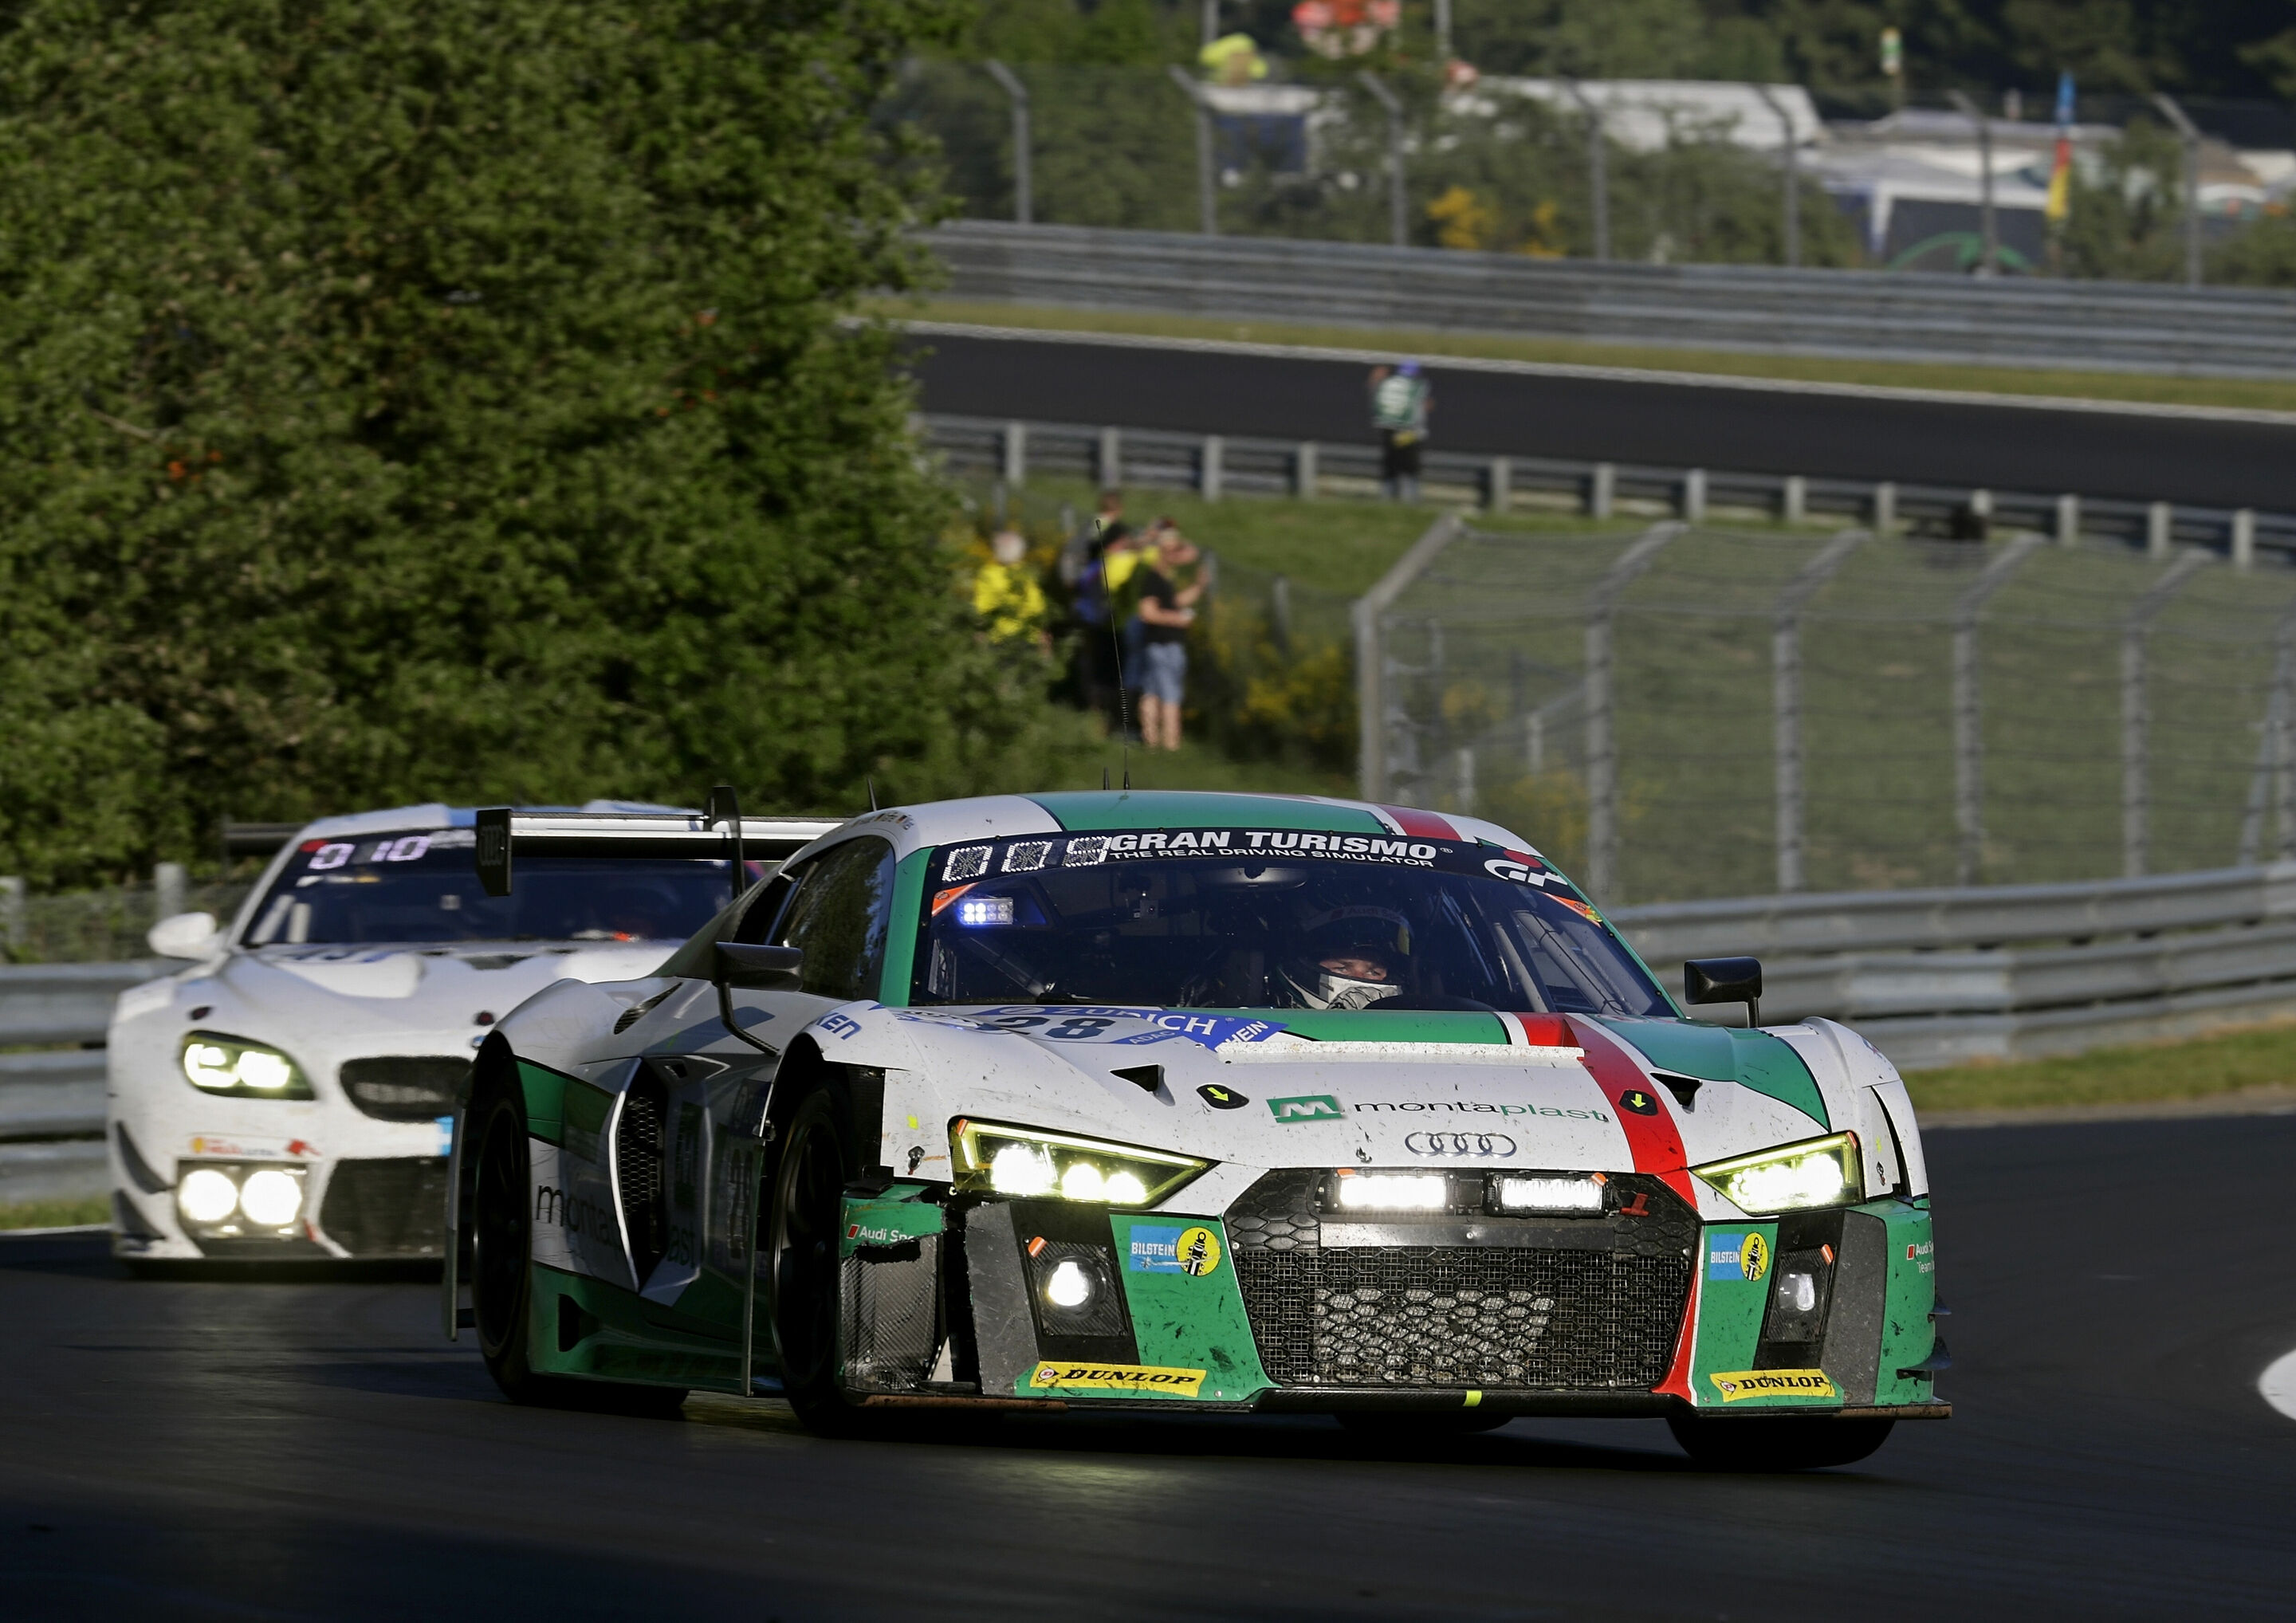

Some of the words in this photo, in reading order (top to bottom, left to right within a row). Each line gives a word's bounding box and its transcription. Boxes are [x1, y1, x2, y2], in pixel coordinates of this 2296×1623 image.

[1110, 831, 1230, 851] GRAN
[1245, 831, 1436, 860] TURISMO
[1160, 848, 1209, 857] REAL
[1218, 848, 1307, 858] DRIVING
[1311, 850, 1434, 867] SIMULATOR
[991, 1016, 1117, 1039] 28
[1127, 1030, 1176, 1044] ADAC
[1354, 1101, 1610, 1122] montaplast
[859, 1226, 887, 1240] Audi
[1132, 1242, 1175, 1256] BILSTEIN
[1710, 1251, 1740, 1263] BILSTEIN
[1060, 1370, 1197, 1385] DUNLOP
[1739, 1377, 1826, 1389] DUNLOP
